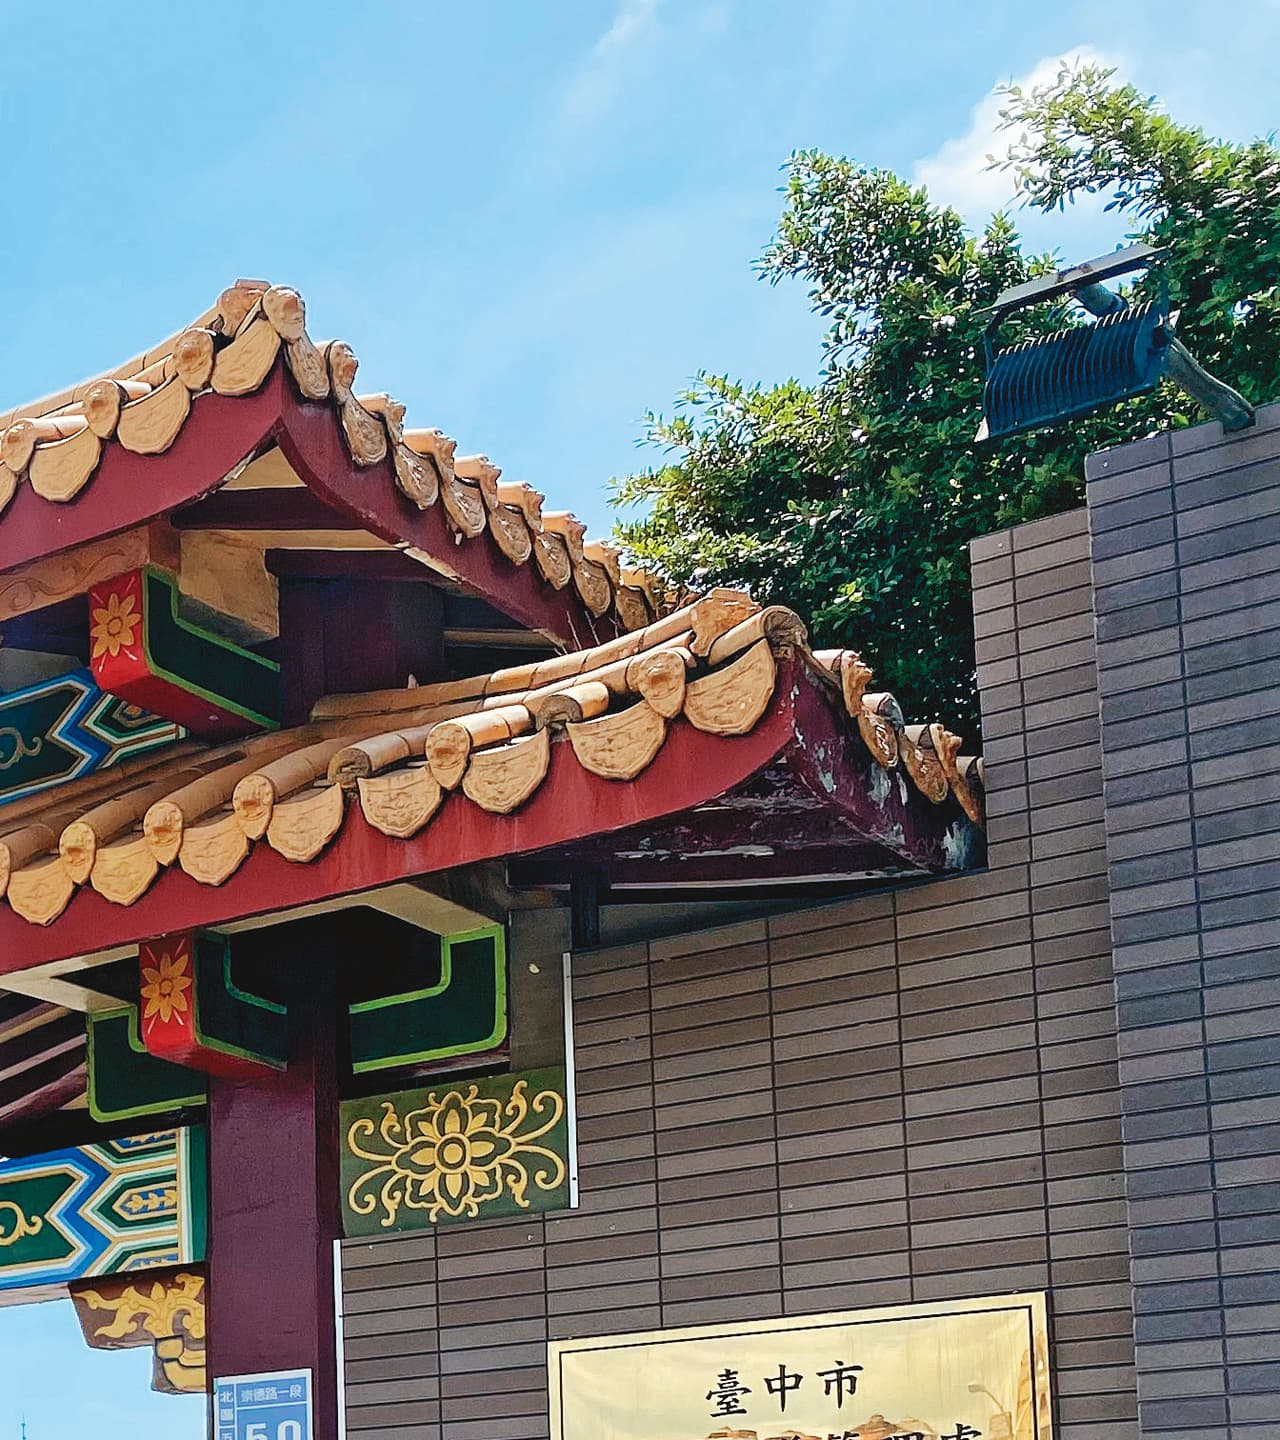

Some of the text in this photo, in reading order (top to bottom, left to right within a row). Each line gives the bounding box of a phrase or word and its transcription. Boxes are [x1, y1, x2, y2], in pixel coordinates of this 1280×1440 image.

[241, 1384, 302, 1402] 崇德路一段
[705, 1359, 865, 1418] 臺中市
